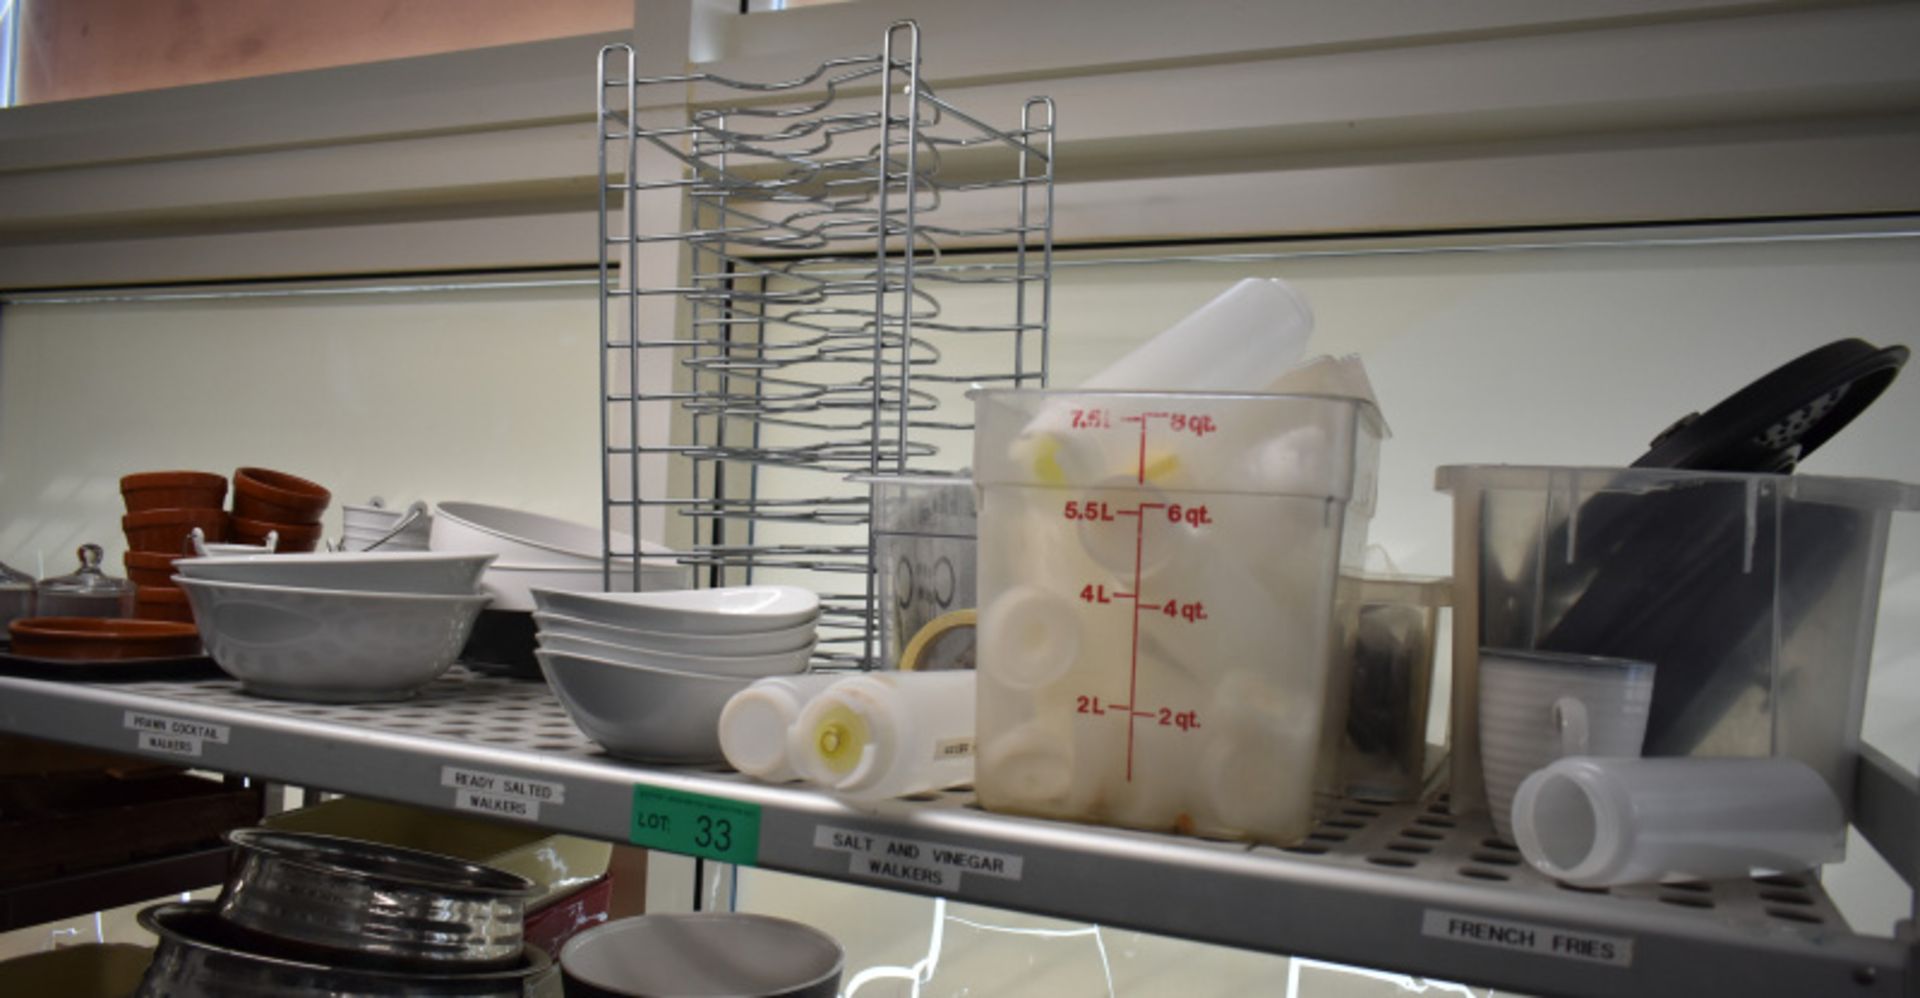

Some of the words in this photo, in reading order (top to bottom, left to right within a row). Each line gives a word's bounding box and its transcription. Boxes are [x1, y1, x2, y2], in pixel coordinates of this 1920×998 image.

[171, 721, 219, 740] COCKTAIL
[455, 771, 495, 790] READY
[503, 780, 553, 800] SALTED
[469, 795, 527, 816] WALKERS
[695, 814, 732, 853] 33
[832, 833, 874, 851] SALT
[886, 841, 920, 861] AND
[932, 848, 1005, 875] VINEGAR
[868, 859, 943, 886] WALKERS
[1449, 918, 1535, 948] FRENCH
[1552, 934, 1616, 961] FRIES
